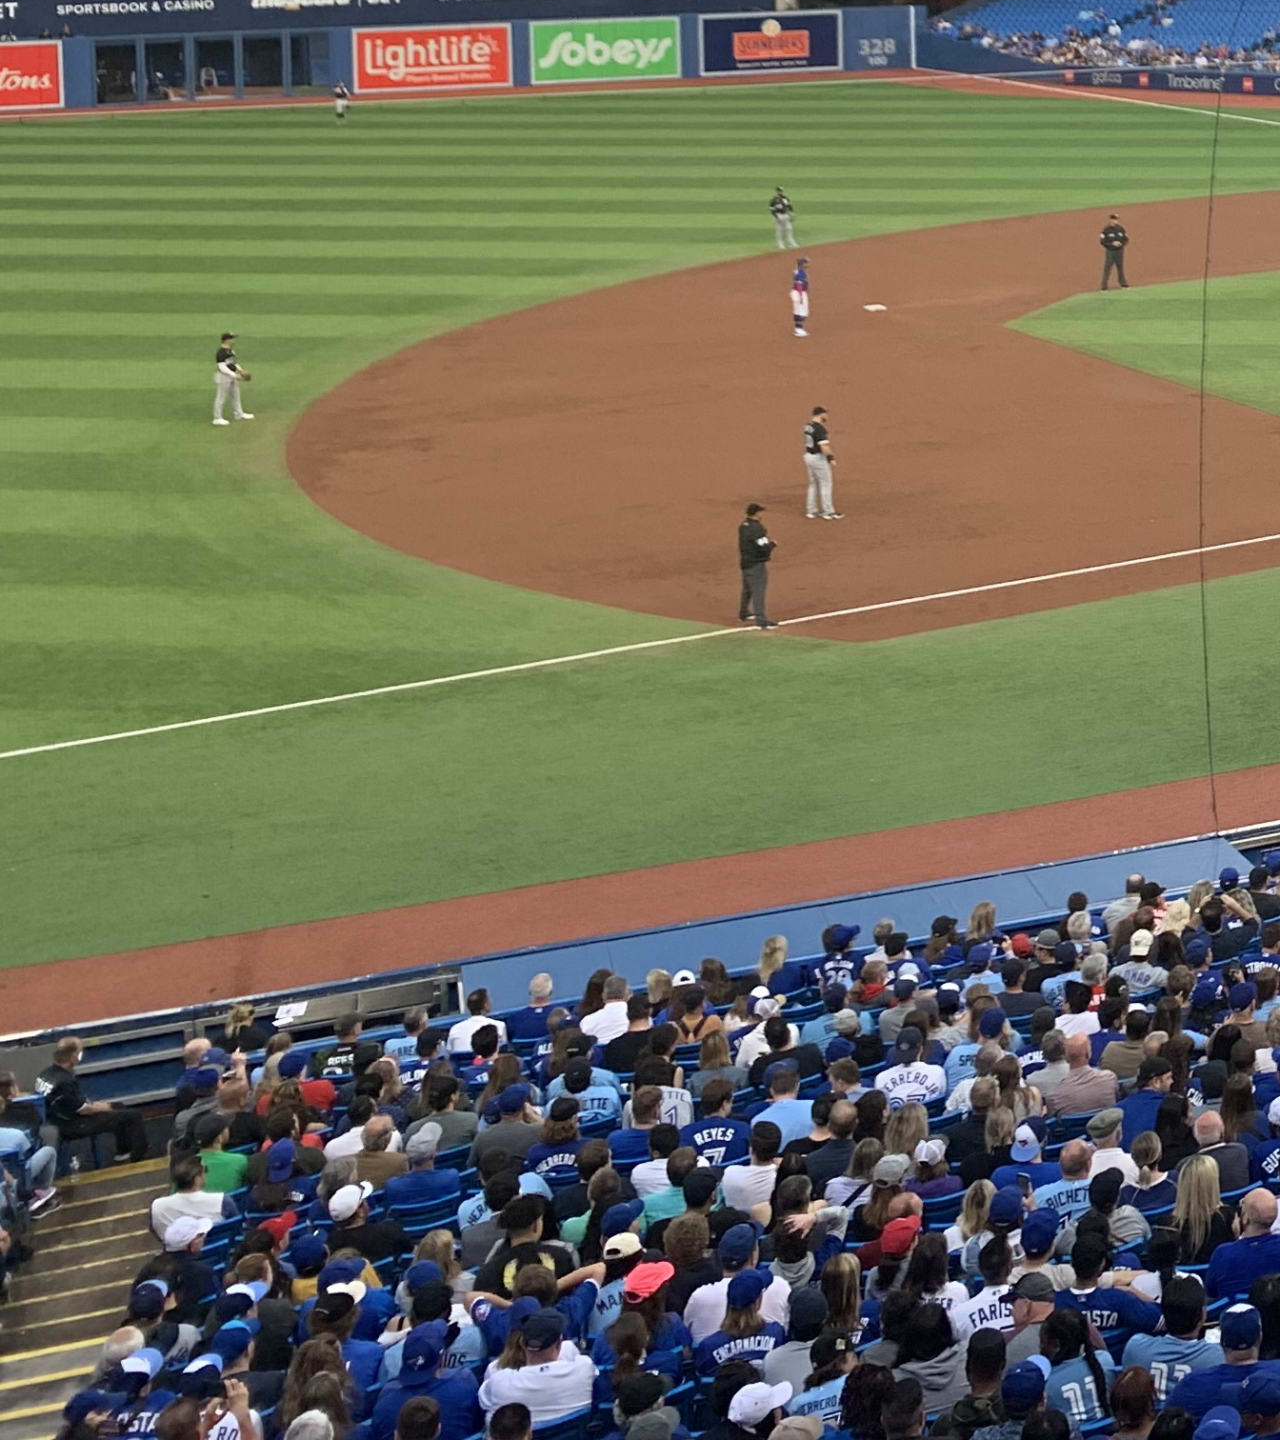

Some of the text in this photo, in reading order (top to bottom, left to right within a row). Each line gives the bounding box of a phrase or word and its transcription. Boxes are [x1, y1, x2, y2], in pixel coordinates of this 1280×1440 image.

[56, 0, 215, 16] SPORTSBOOK & CASINO
[539, 31, 672, 70] Sobeys
[859, 38, 896, 55] 328
[364, 35, 491, 81] Lightlife
[694, 1127, 734, 1147] REYES
